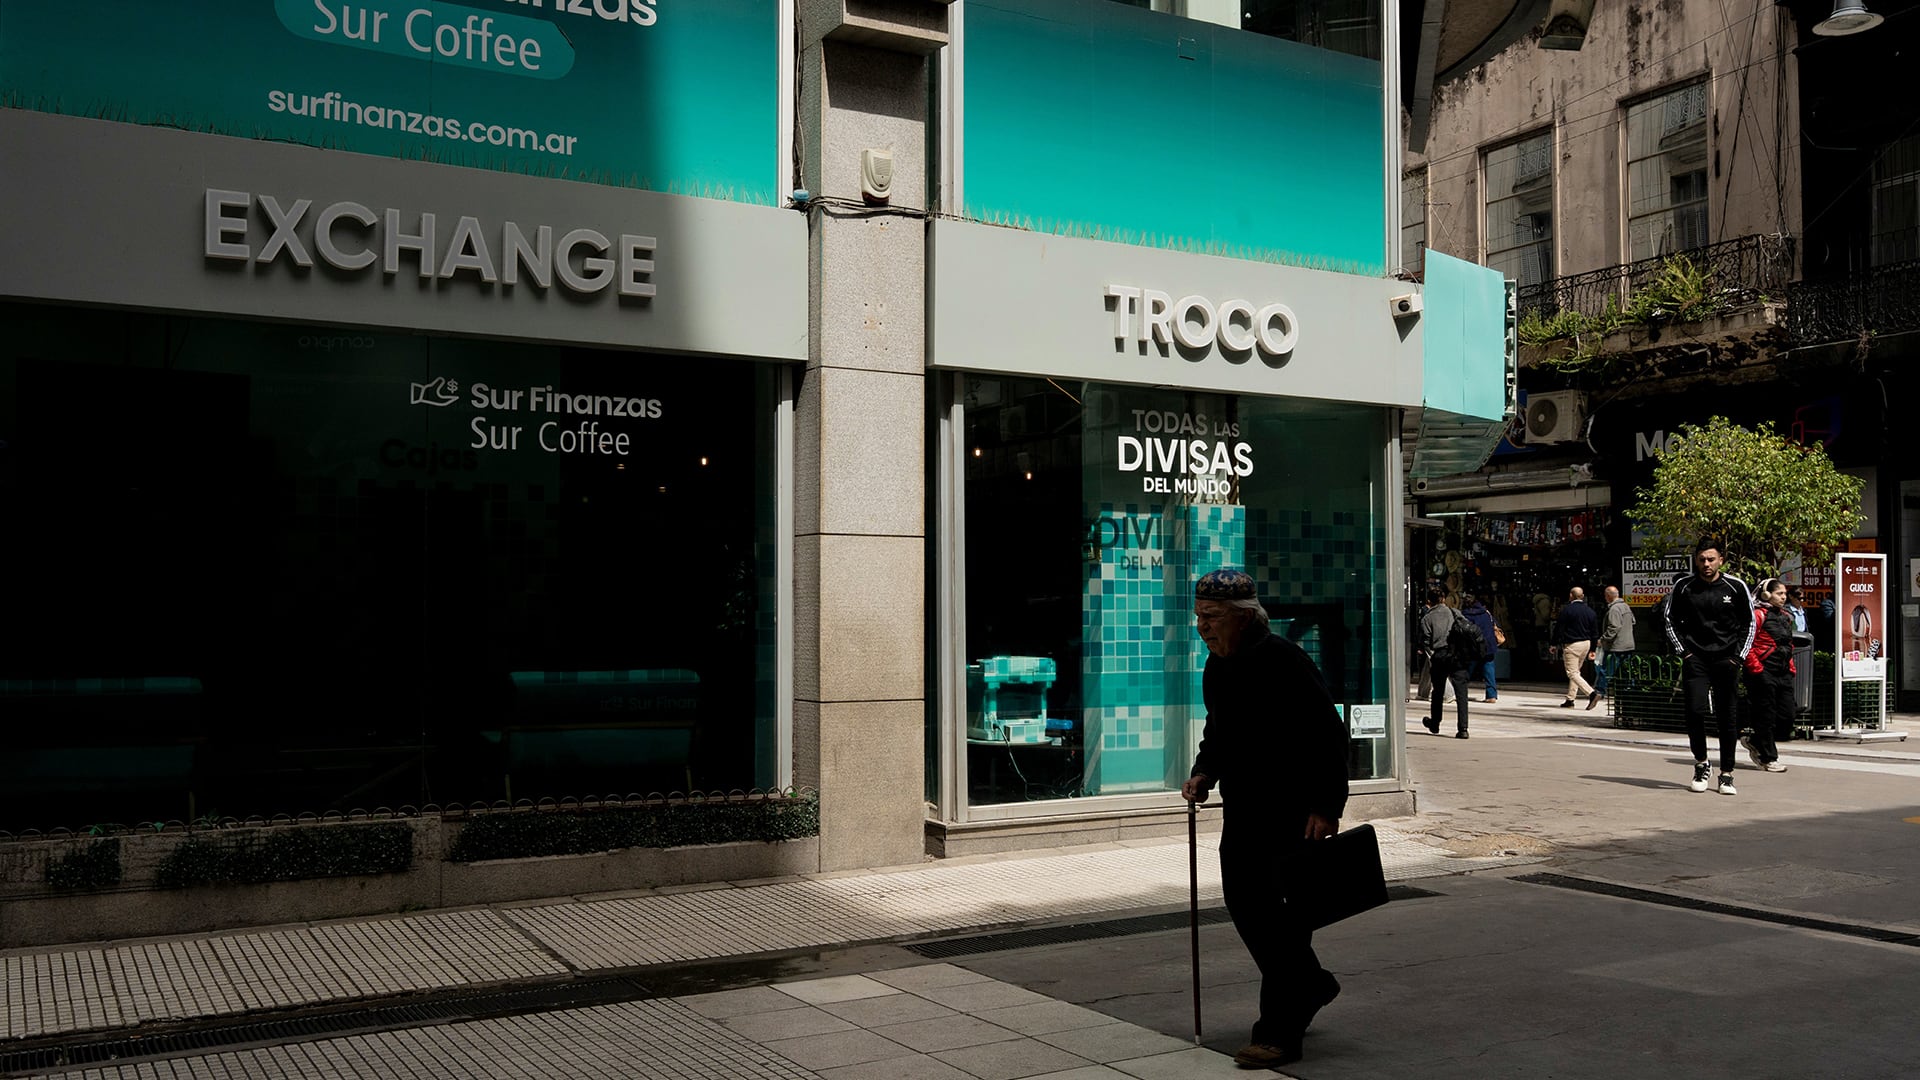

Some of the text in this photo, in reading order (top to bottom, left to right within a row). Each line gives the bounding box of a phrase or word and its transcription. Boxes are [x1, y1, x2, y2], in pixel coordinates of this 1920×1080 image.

[313, 0, 542, 71] Sur Coffee
[267, 89, 578, 156] surfinanzas.com.ar
[204, 187, 657, 299] EXCHANGE
[1103, 284, 1300, 357] TROCO
[470, 382, 663, 419] Sur Finanzas
[470, 416, 631, 455] Sur Coffee
[1131, 408, 1241, 438] TODAS LAS
[379, 439, 479, 475] Cajas
[1117, 435, 1254, 477] DIVISAS
[1143, 476, 1232, 496] DEL MUNDO
[1625, 559, 1689, 572] BERRUETA
[1632, 579, 1674, 587] ALQUIL
[1632, 586, 1673, 594] 4327-00
